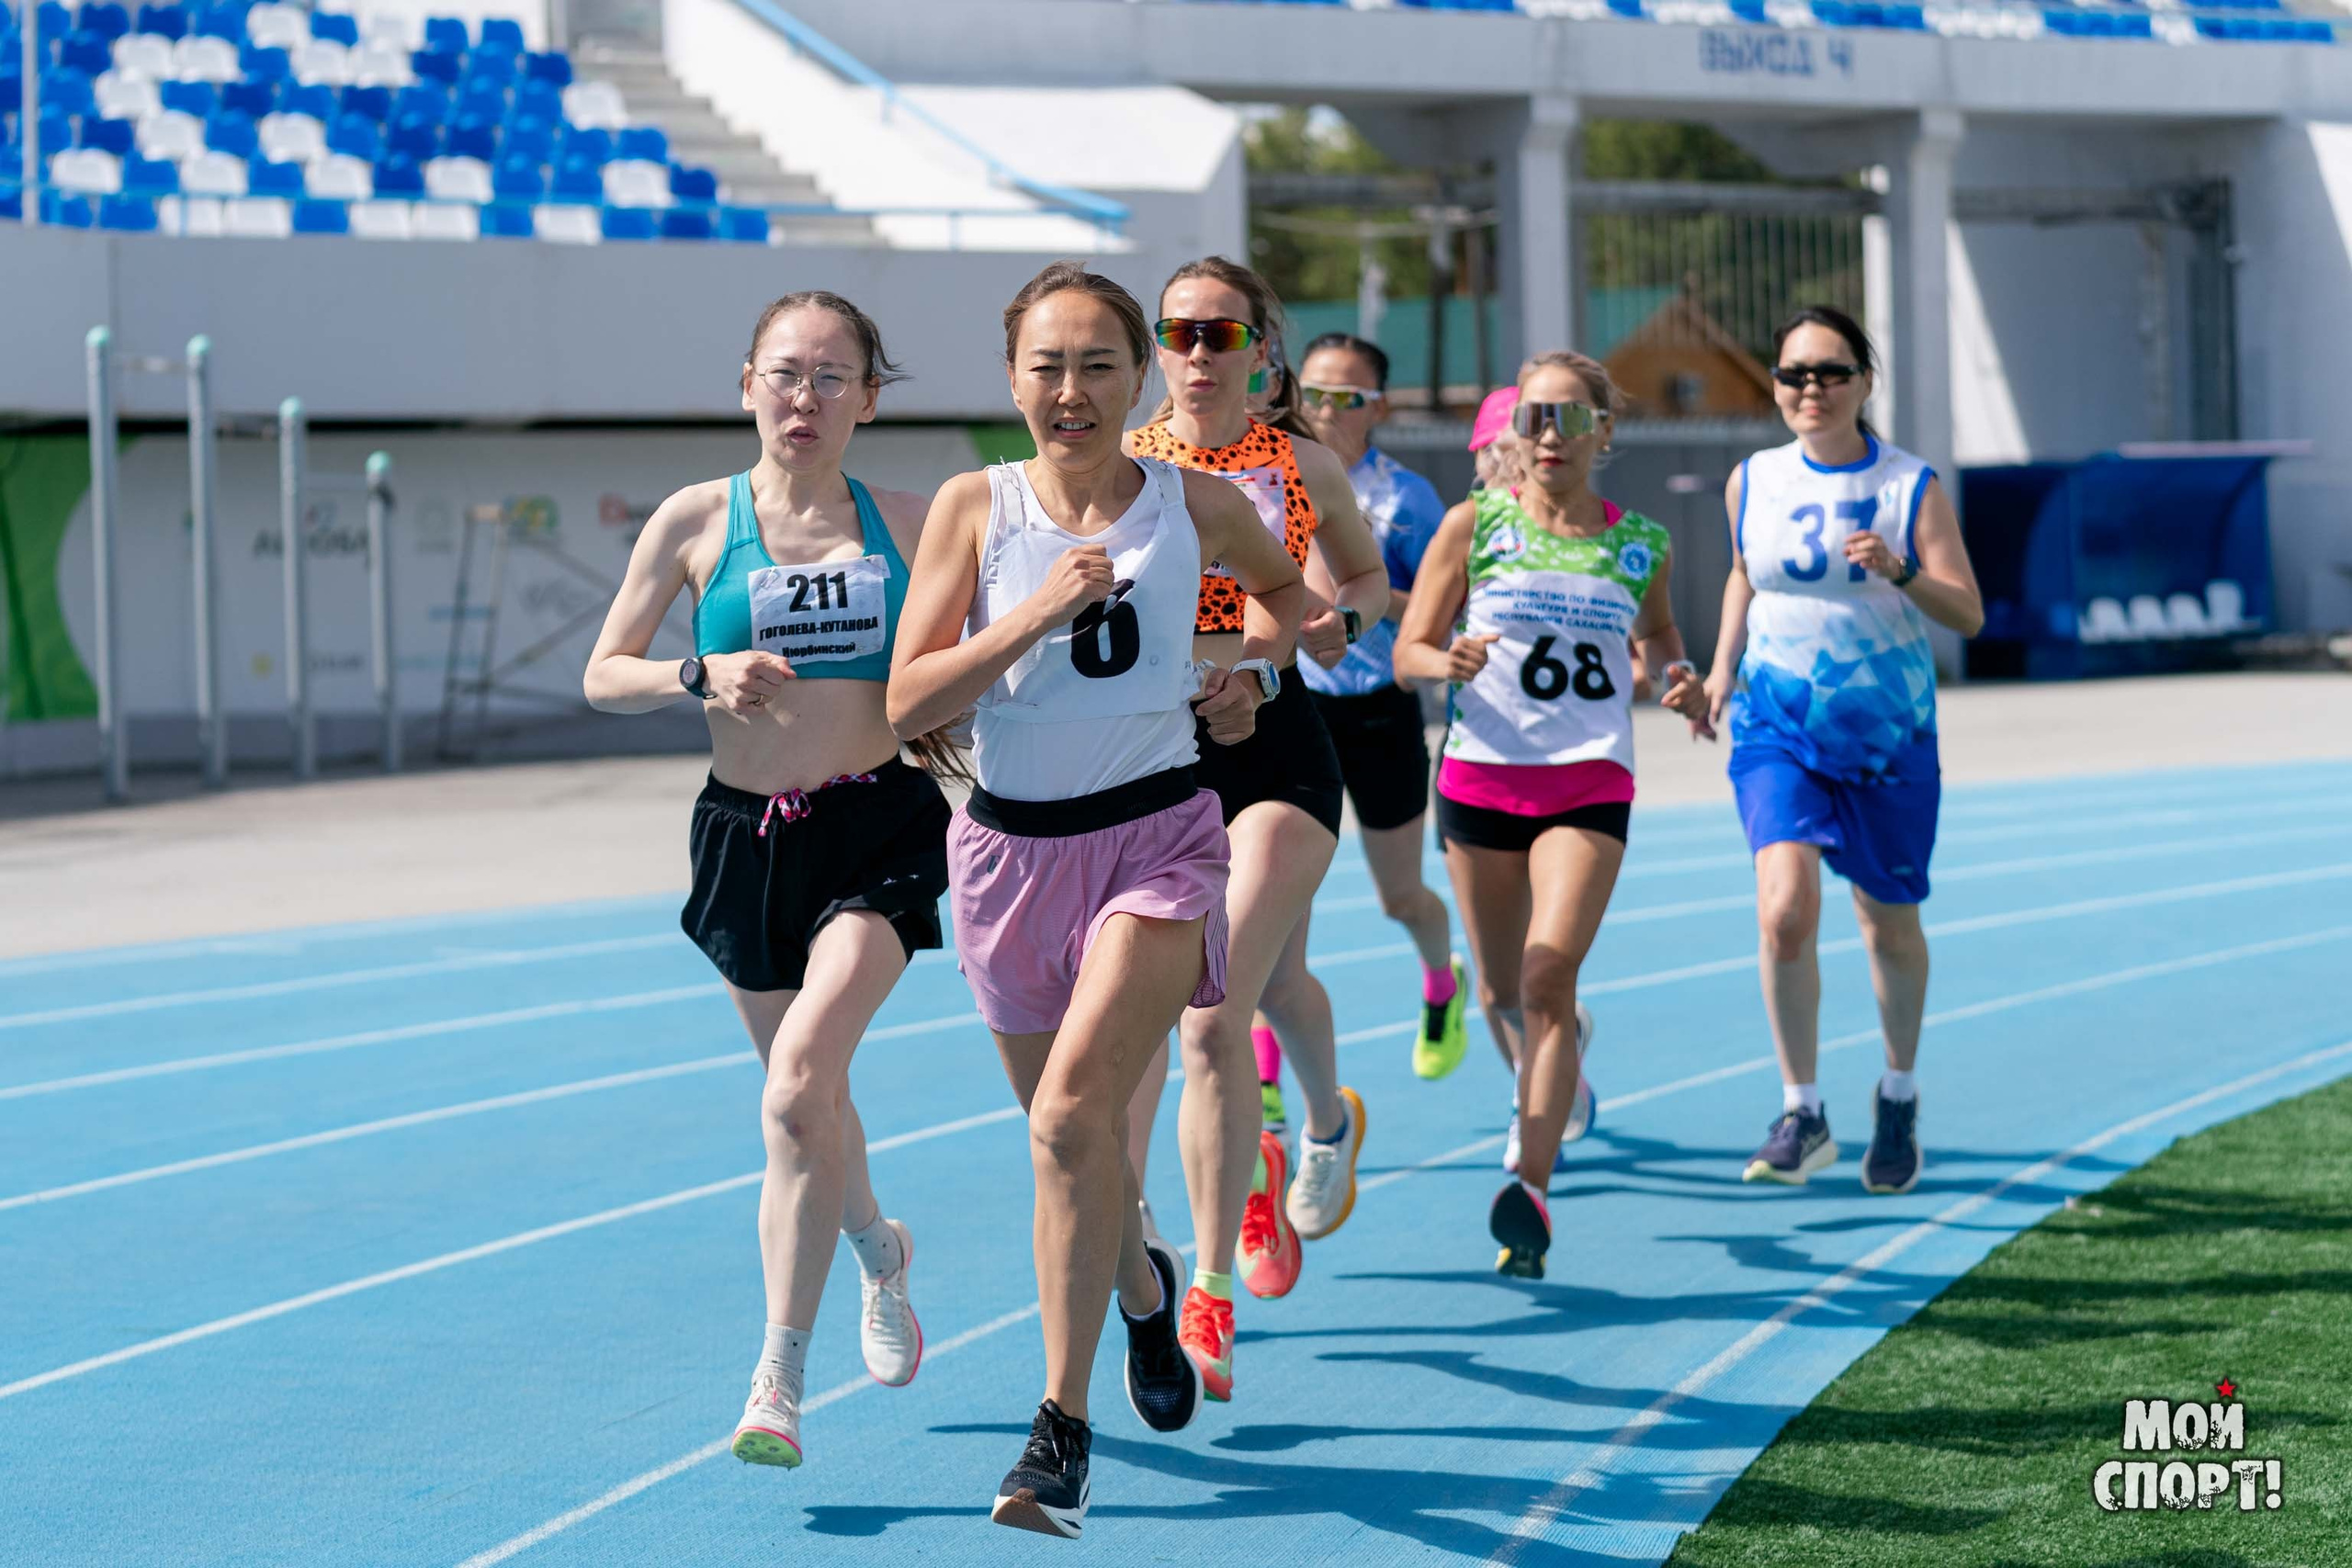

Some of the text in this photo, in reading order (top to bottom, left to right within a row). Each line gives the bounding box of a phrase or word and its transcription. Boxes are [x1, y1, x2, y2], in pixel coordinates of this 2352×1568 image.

[1782, 495, 1878, 582] 37
[787, 571, 848, 613] 211
[760, 616, 878, 641] ГОГОЛЕВА-КУТАНОВА
[782, 641, 855, 659] Нюрбинский
[1071, 579, 1139, 678] 6
[1521, 635, 1616, 701] 68
